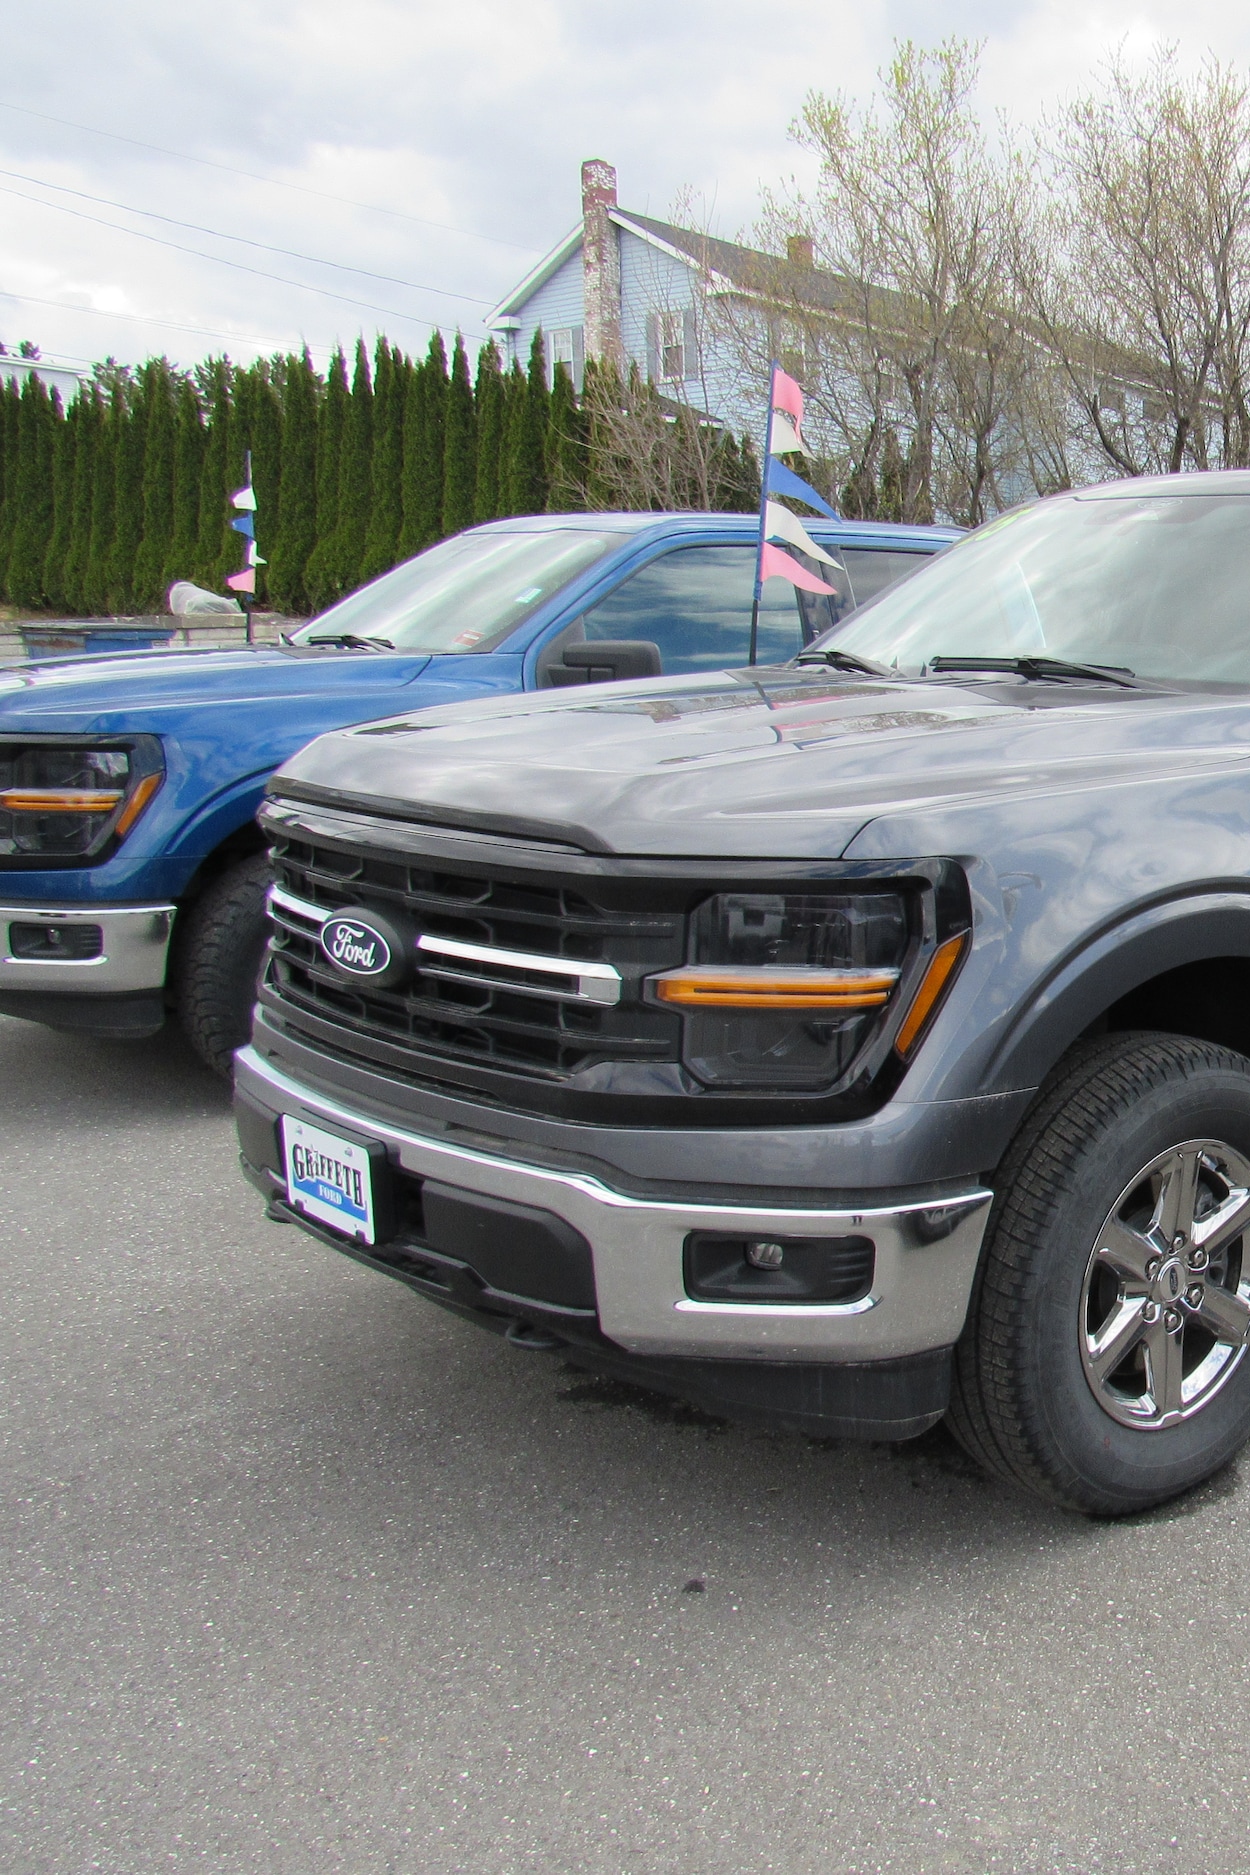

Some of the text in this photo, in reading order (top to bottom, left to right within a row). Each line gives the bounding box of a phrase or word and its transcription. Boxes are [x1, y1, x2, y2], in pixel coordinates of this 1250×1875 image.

[332, 924, 376, 967] Ford
[293, 1143, 363, 1207] GRIFFETH
[319, 1184, 342, 1205] FORD
